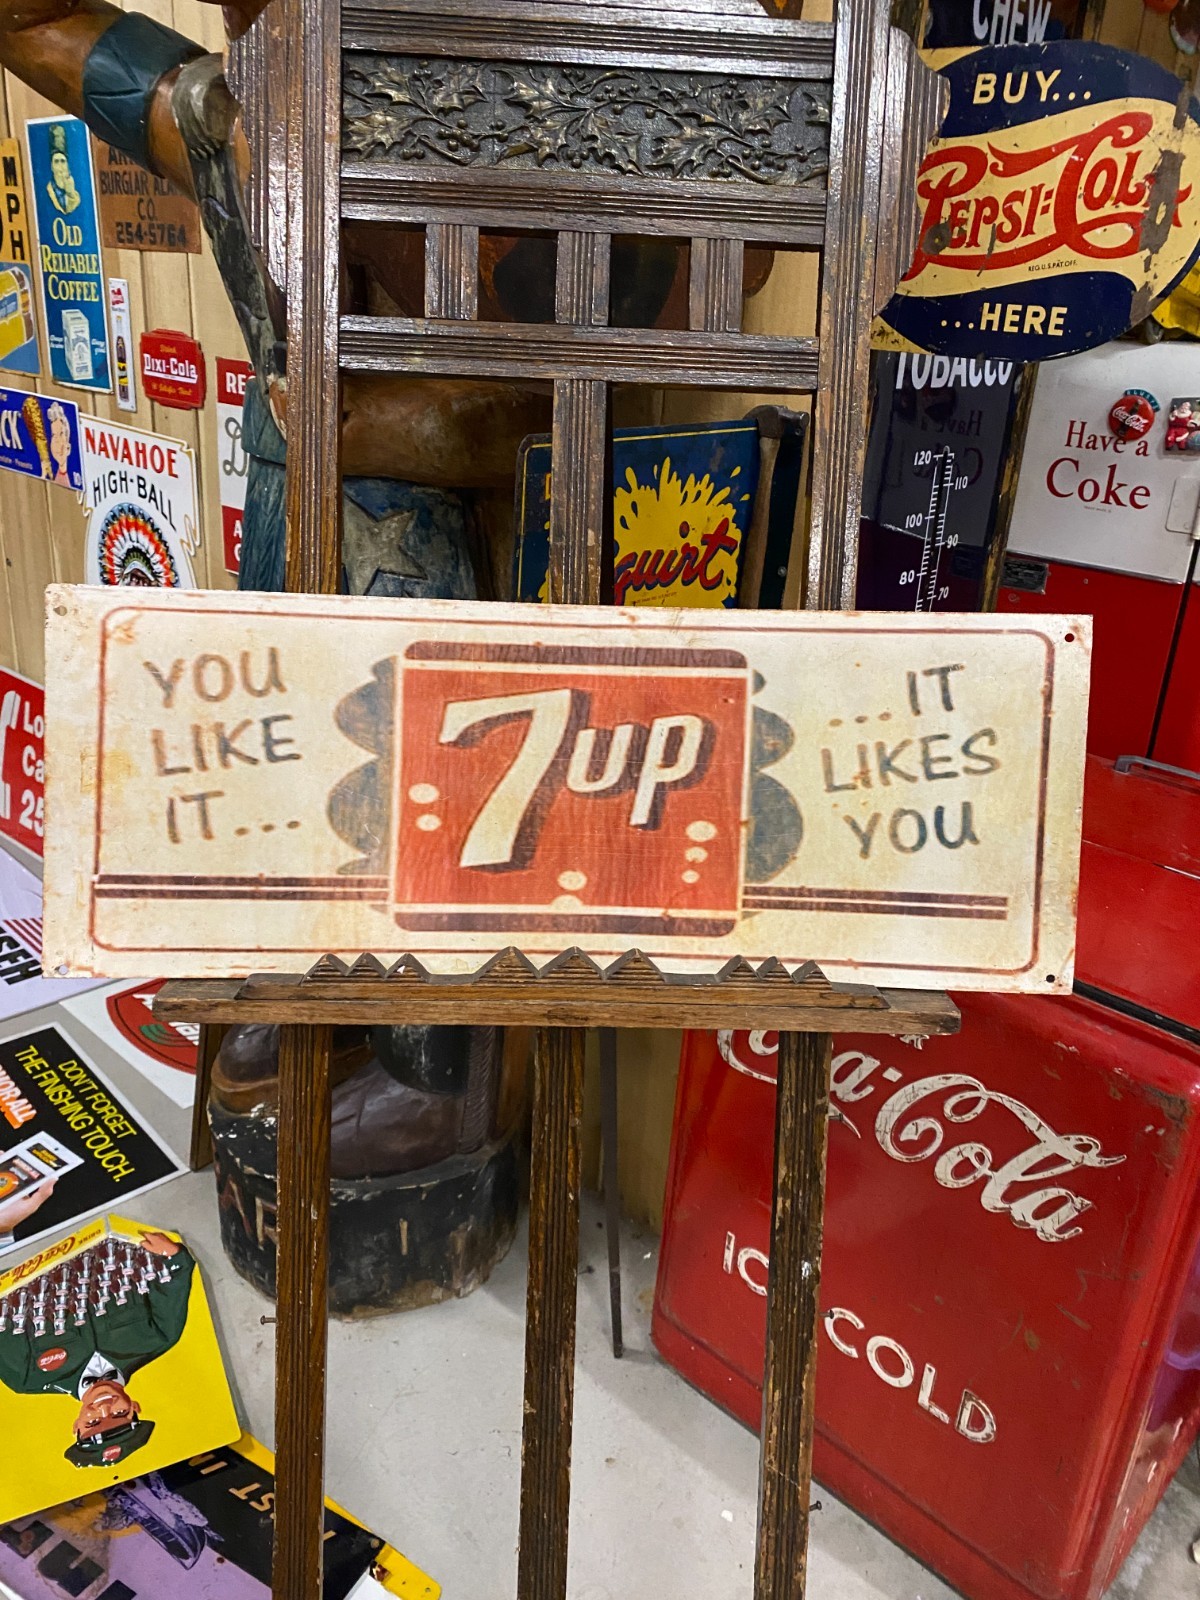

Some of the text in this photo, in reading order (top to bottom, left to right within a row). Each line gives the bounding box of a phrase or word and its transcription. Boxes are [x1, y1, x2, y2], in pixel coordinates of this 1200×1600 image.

[973, 0, 1051, 45] CHEW
[100, 170, 183, 195] BURGLAR ALA
[53, 217, 82, 246] OLD
[41, 245, 99, 274] RELIABLE
[48, 275, 99, 302] COFFEE
[0, 409, 23, 450] CK
[1065, 420, 1150, 457] Have a
[84, 426, 179, 479] NAVAHOE
[914, 450, 932, 465] 120
[93, 469, 177, 532] HIGH-BALL
[954, 476, 968, 490] 110
[1046, 457, 1151, 510] Coke
[905, 513, 923, 529] 100
[946, 533, 959, 549] 90
[613, 517, 738, 606] quirt
[899, 569, 915, 586] 80
[937, 586, 949, 601] 70
[143, 646, 287, 709] YOU
[150, 713, 303, 778] LIKE
[820, 727, 1000, 794] LIKES
[842, 800, 981, 860] YOU
[15, 1045, 50, 1074] THE
[32, 1069, 95, 1132] FINISHING
[58, 1060, 138, 1139] DON'T FORGET
[12, 1236, 76, 1285] Coca-Cola
[723, 1231, 997, 1444] IC COLD
